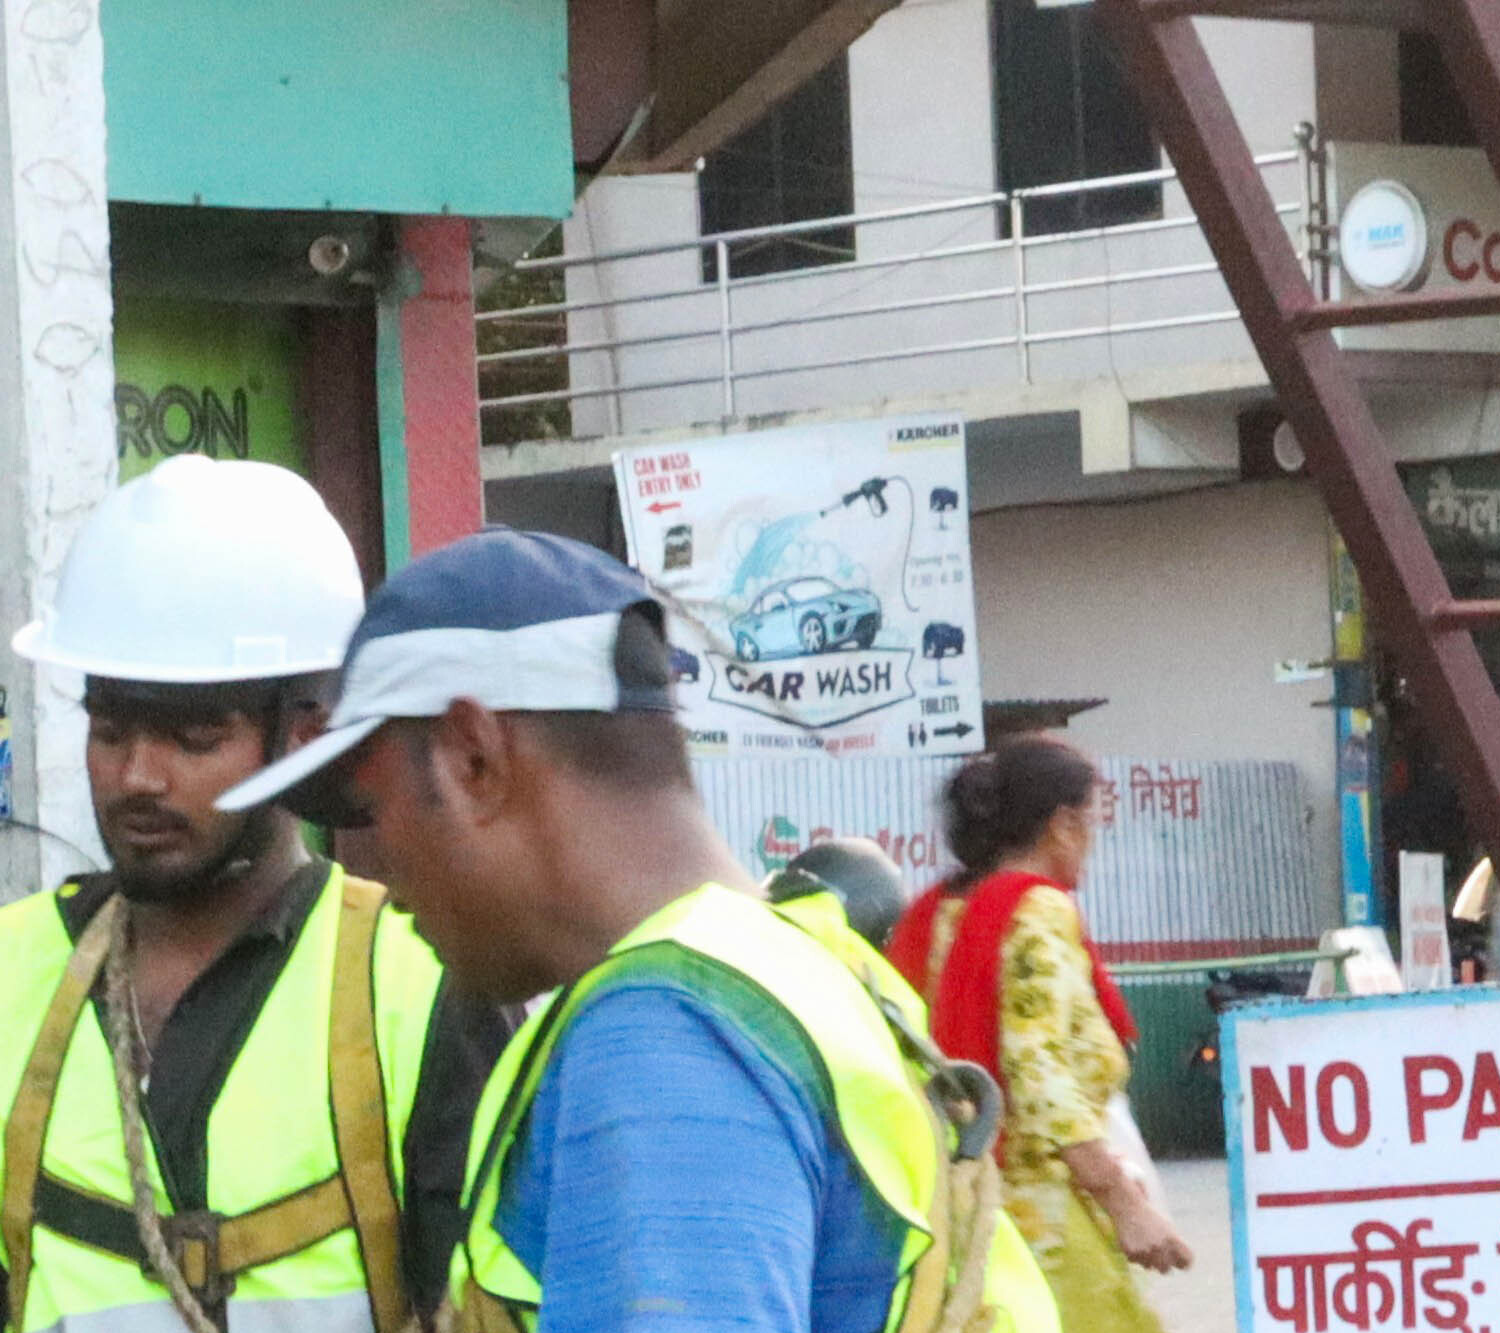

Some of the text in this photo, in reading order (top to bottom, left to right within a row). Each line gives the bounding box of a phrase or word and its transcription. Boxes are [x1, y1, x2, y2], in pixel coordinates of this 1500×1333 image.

[725, 661, 893, 701] CAR WASH
[1251, 1061, 1370, 1153] NO
